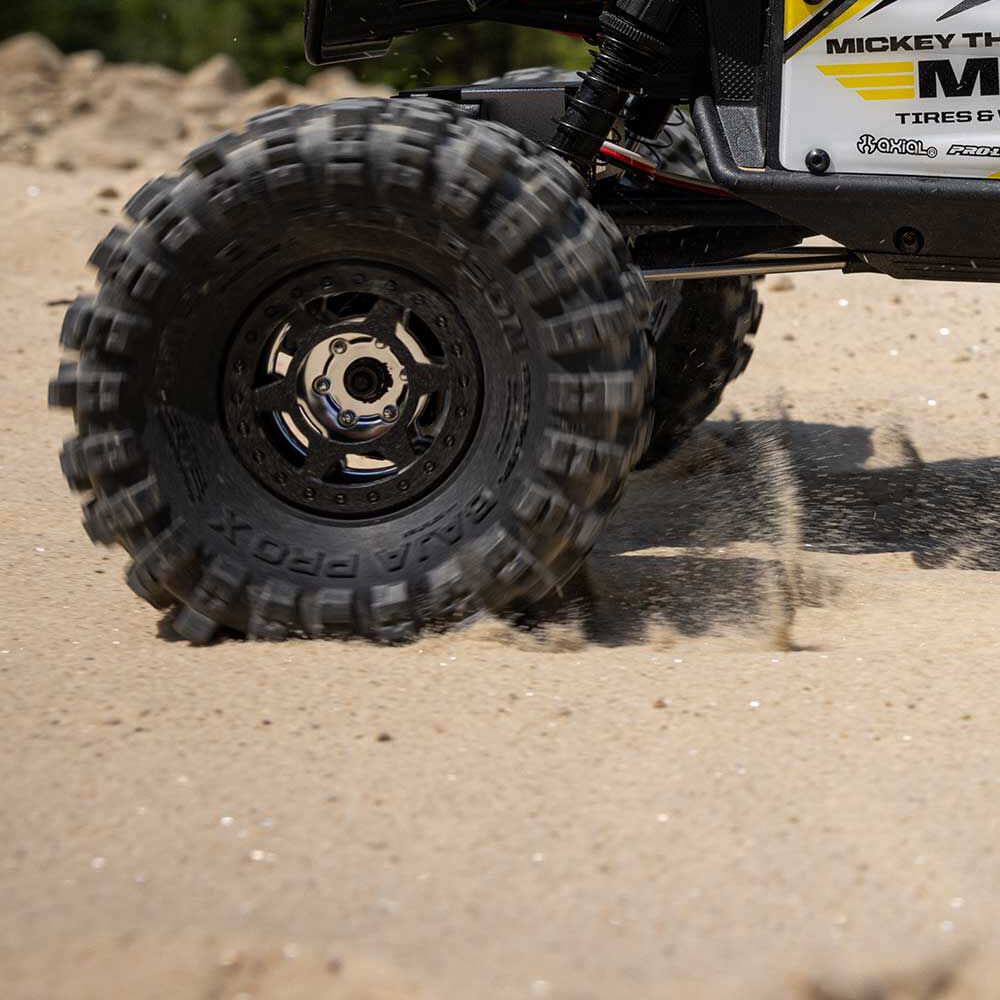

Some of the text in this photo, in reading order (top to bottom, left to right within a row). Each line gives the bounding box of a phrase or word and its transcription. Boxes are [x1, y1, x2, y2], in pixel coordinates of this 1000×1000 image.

[826, 33, 959, 54] MICKEY
[895, 110, 973, 125] TIRES
[976, 109, 995, 123] &
[206, 509, 253, 547] X
[252, 537, 362, 578] PRO
